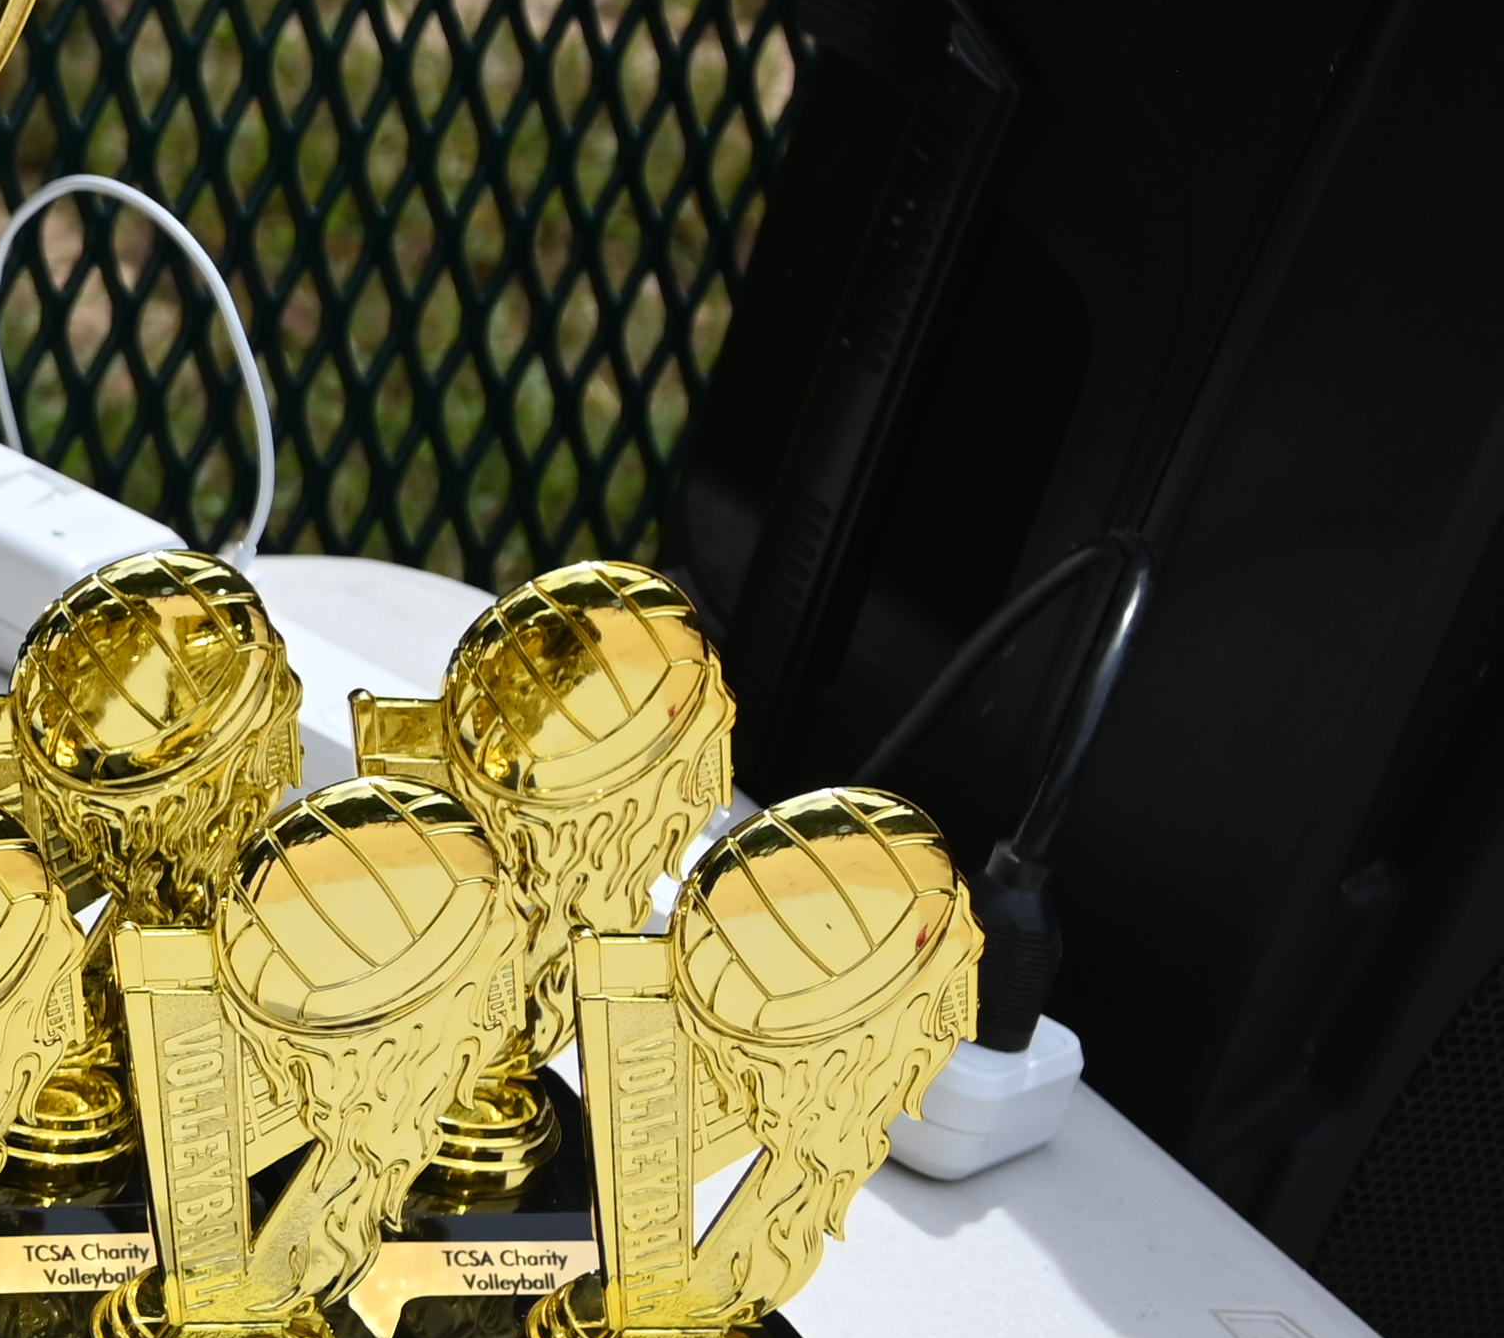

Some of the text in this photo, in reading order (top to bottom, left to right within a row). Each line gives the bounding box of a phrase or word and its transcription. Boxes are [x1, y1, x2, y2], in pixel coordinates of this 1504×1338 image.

[163, 1018, 243, 1310] VOLLEYBALL
[617, 1026, 684, 1316] VOLLEYBALL
[23, 1242, 150, 1264] TCSA Charity
[441, 1248, 568, 1271] TCSA Charity
[43, 1265, 137, 1289] Volleyball
[462, 1272, 556, 1294] Volleyball
